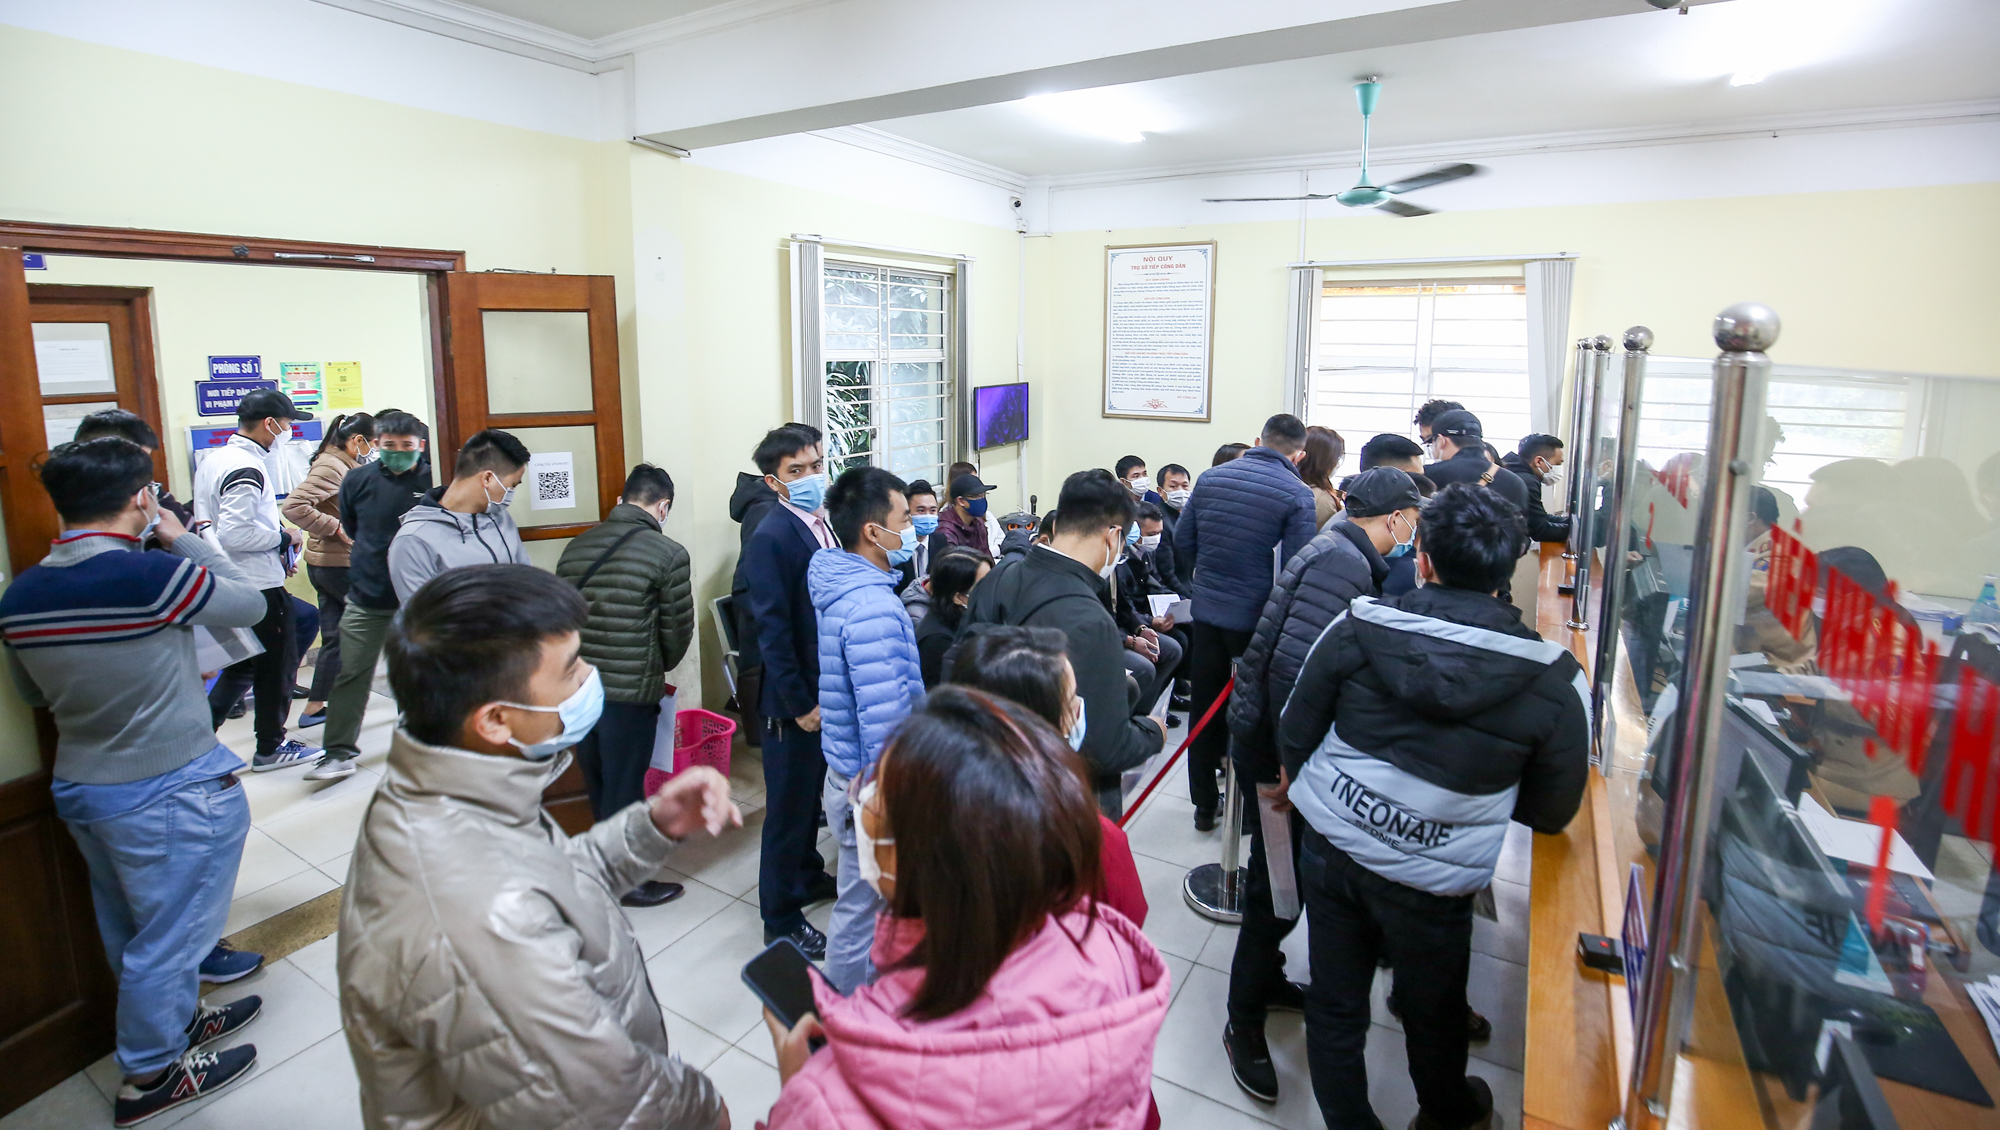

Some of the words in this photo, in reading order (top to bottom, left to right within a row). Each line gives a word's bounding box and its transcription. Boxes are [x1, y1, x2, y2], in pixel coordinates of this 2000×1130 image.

[213, 361, 241, 374] PHÒNG
[242, 360, 253, 374] SỐ
[254, 363, 259, 373] 1
[220, 387, 235, 397] TIẾP
[213, 400, 233, 409] PHẠM
